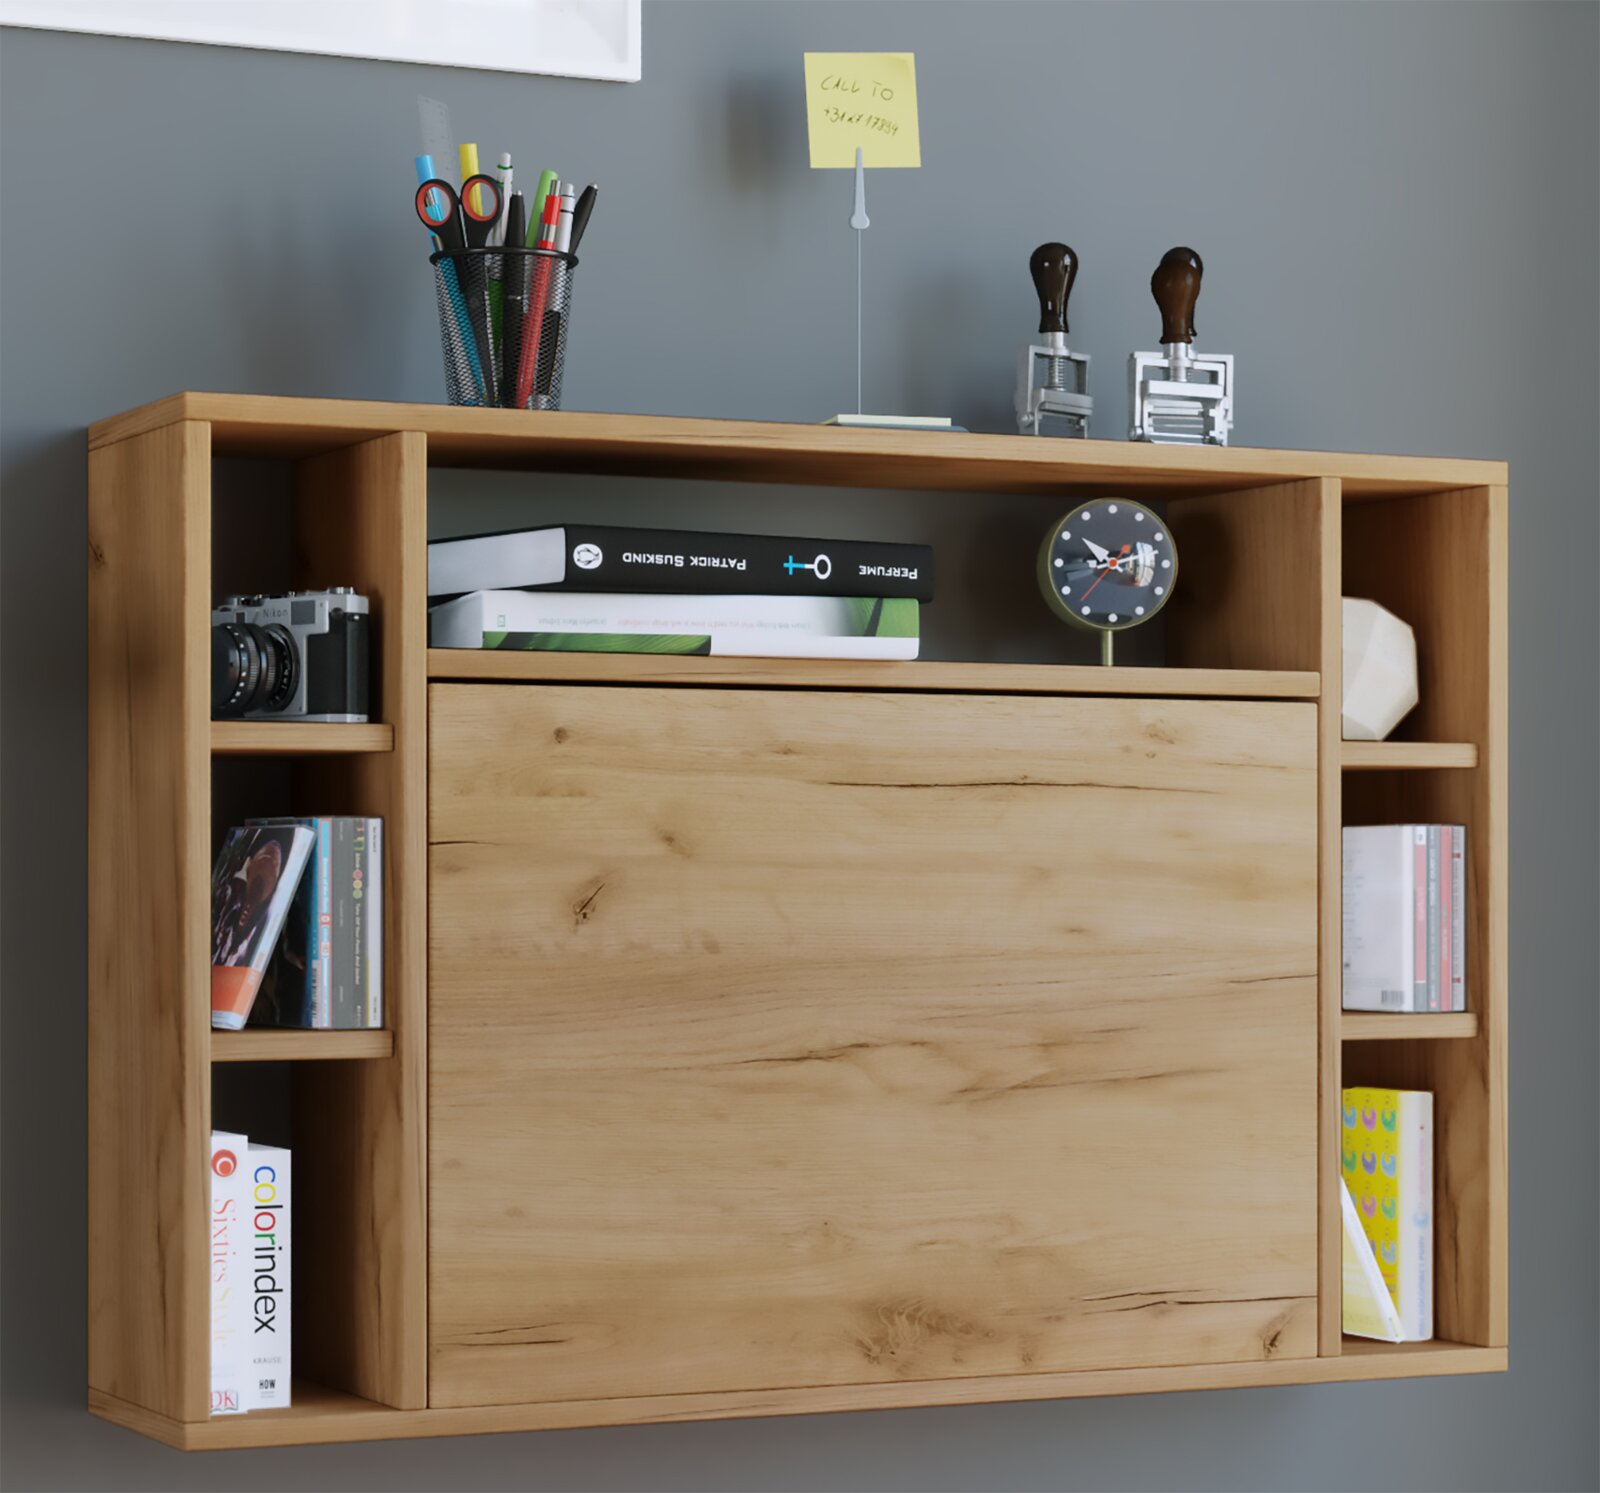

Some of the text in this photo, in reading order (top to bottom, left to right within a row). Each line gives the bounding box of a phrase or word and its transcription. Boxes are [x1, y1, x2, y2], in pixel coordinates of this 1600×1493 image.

[821, 75, 894, 101] CALL TO
[622, 552, 746, 571] PATRICK SUSKIND
[858, 565, 918, 579] PERFUME
[263, 609, 288, 617] Nikon
[212, 1198, 237, 1283] Sixties
[253, 1165, 284, 1334] colorindex
[258, 1379, 276, 1390] HOW
[209, 1391, 236, 1410] DK
